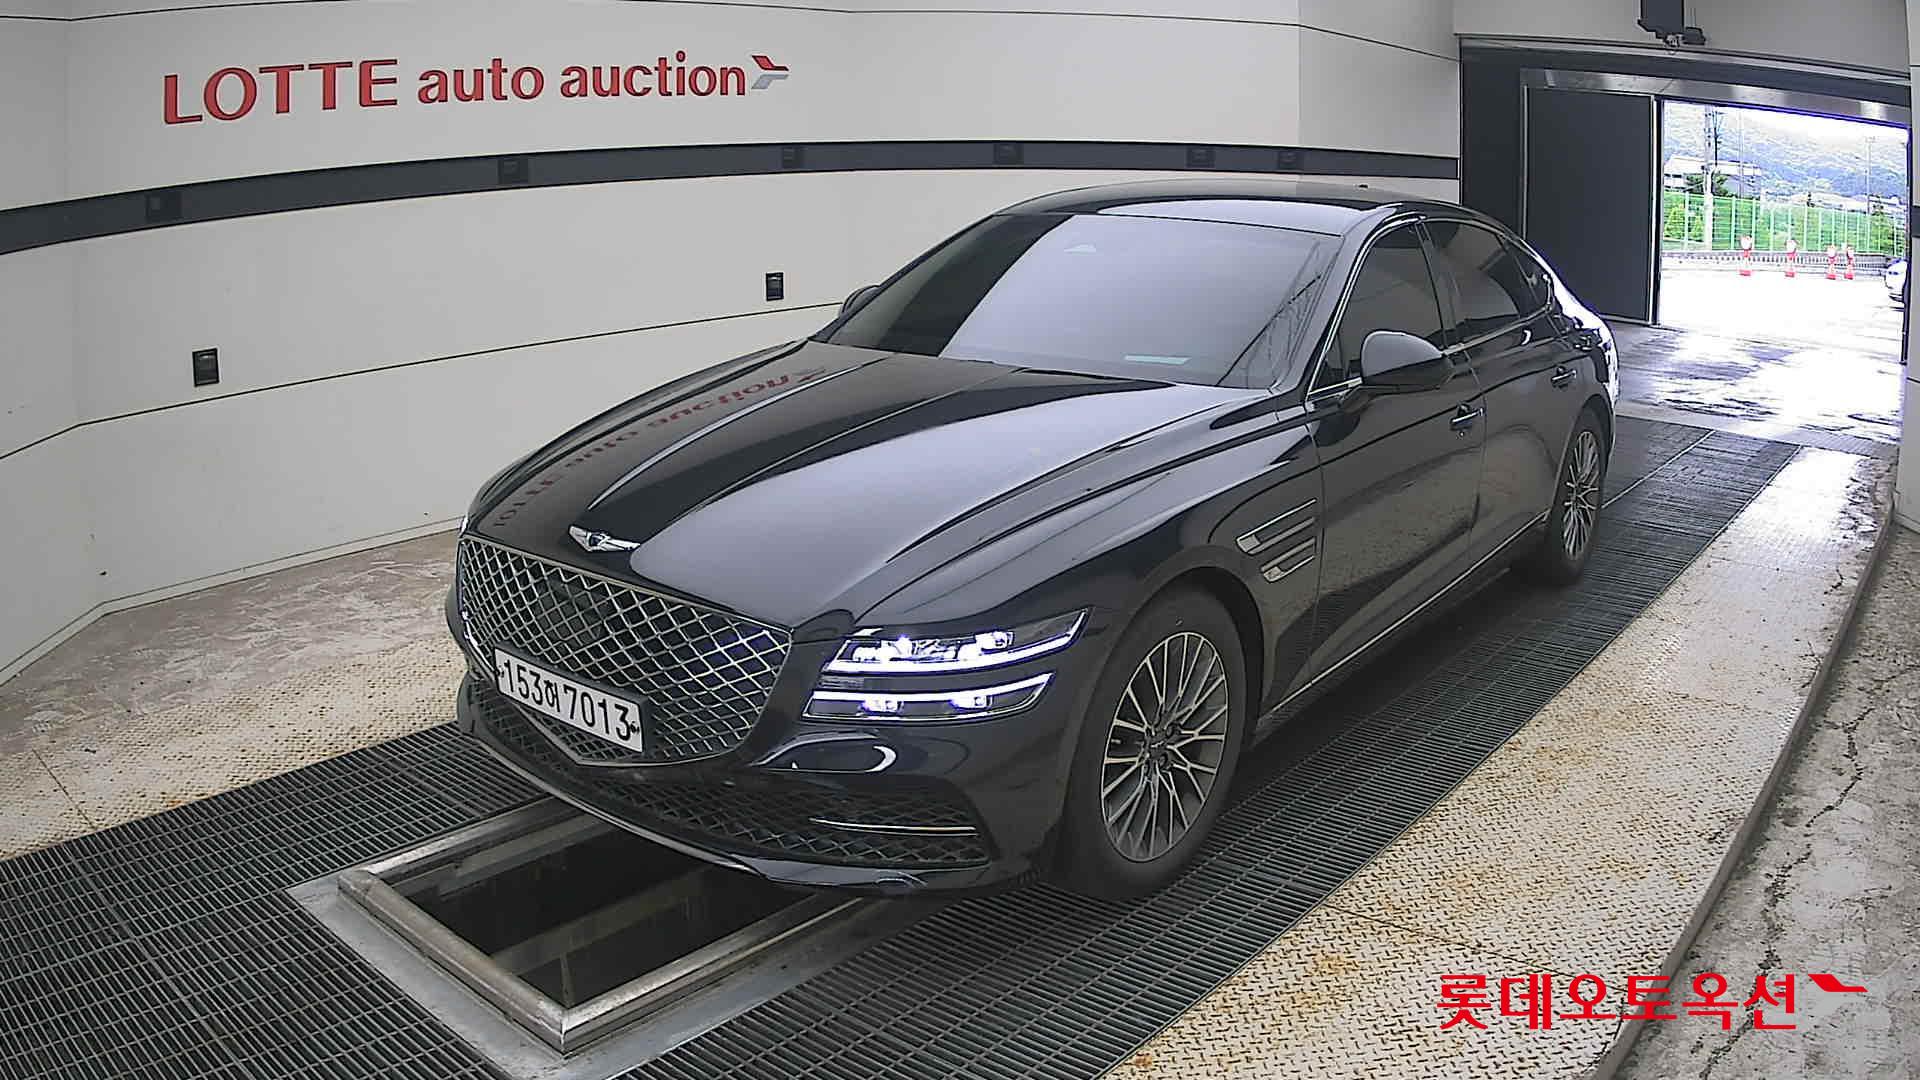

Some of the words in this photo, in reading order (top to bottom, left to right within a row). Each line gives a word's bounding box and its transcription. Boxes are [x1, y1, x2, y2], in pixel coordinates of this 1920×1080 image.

[164, 59, 397, 125] LOTTE
[418, 58, 545, 104] auto
[560, 50, 747, 97] auction
